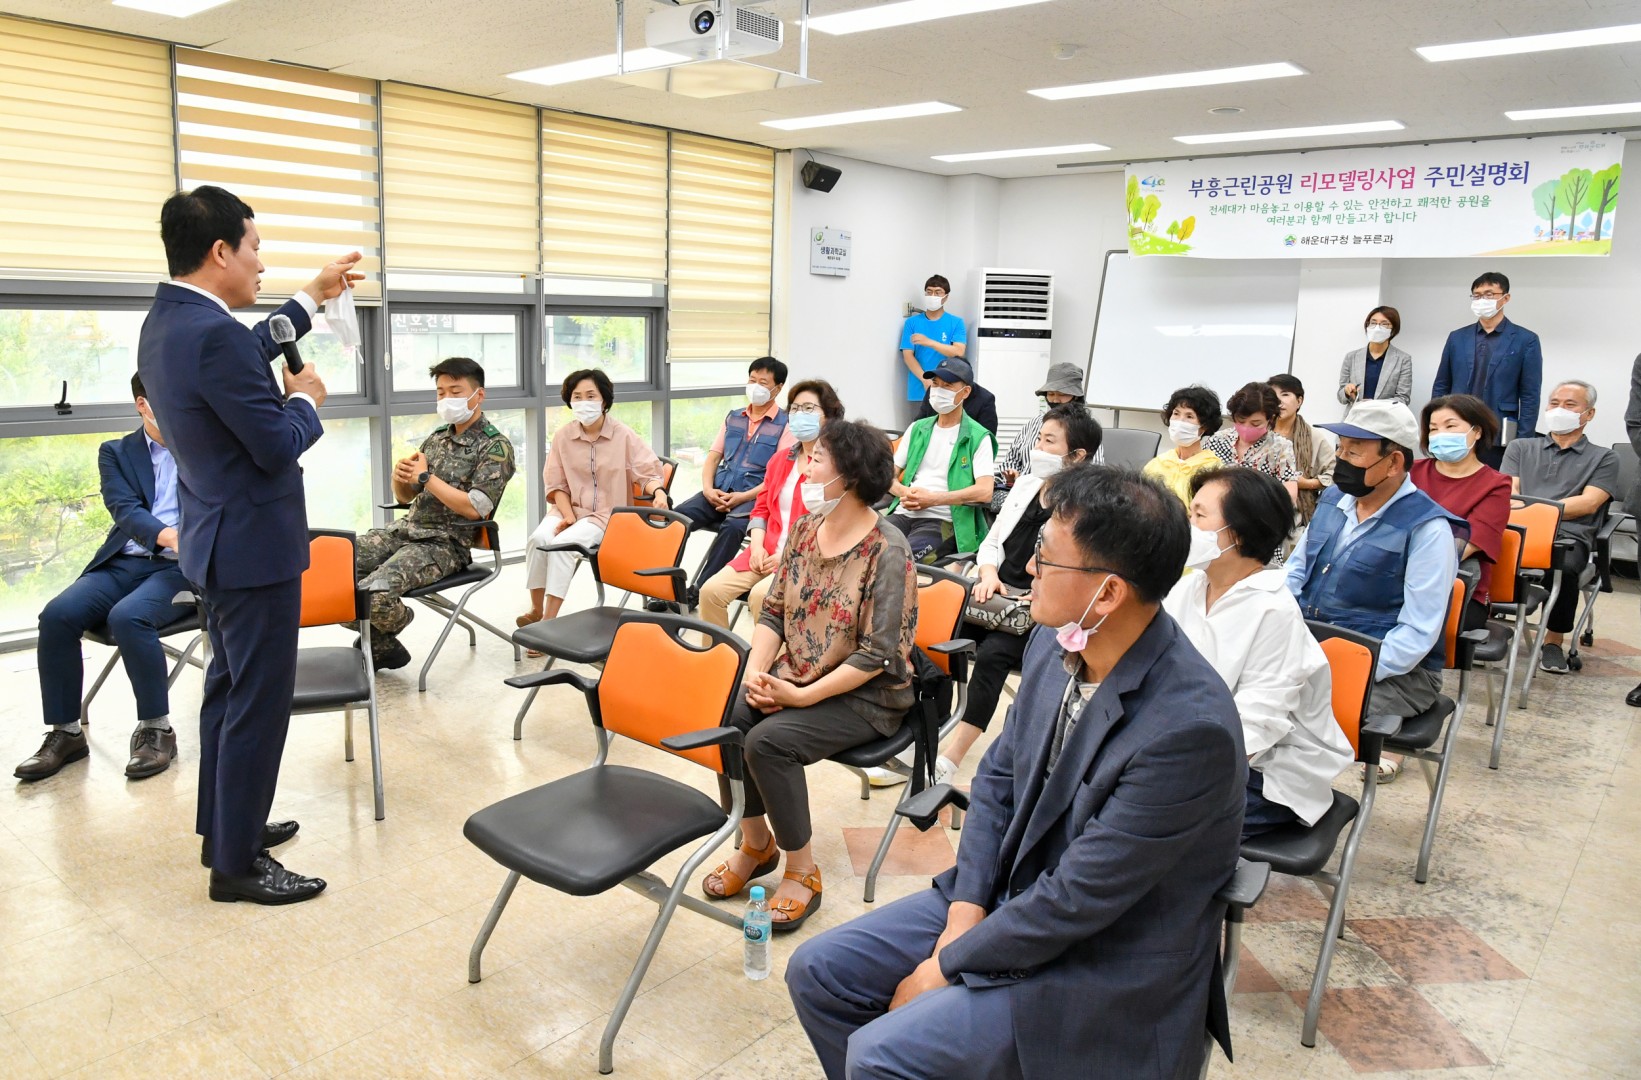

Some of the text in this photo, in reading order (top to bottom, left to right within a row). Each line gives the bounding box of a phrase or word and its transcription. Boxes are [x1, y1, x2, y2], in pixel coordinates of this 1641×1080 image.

[1188, 160, 1530, 199] 부흥근린공원 리모델링사업 주민설명회
[1209, 194, 1492, 216] 전세대가 마음놓고 이용할 수 있는 안전하고 쾌적한 공원을
[1266, 211, 1418, 226] 여러분과 함께 만들고자 합니다
[1301, 234, 1394, 246] 해운대구청 늘푸른과
